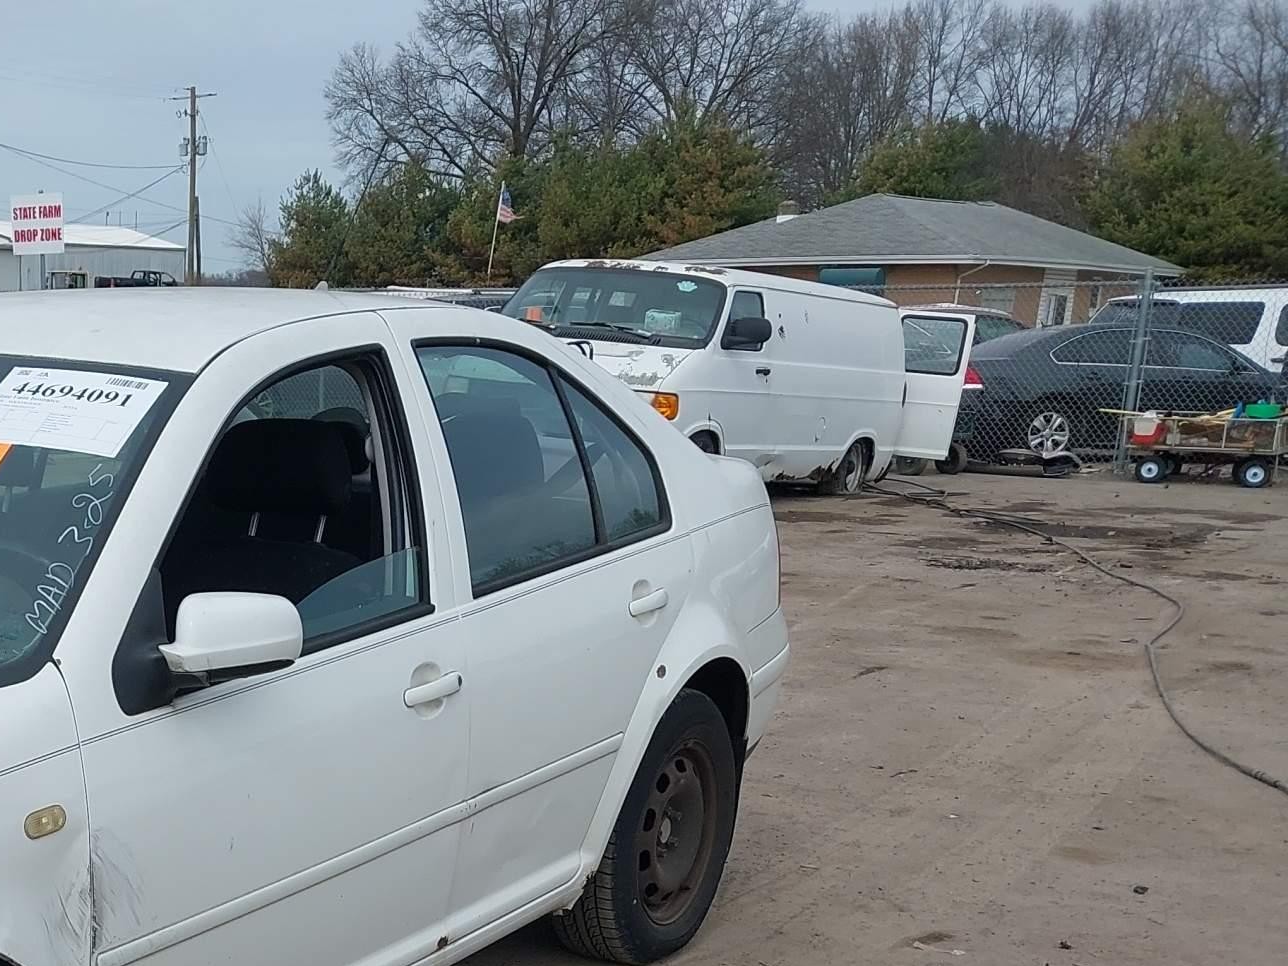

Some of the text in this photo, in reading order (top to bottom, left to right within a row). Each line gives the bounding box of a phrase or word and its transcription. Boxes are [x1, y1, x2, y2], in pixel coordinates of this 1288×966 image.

[12, 204, 61, 220] STATE FARM
[14, 227, 62, 243] DROP ZONE
[12, 381, 132, 408] 44694091
[25, 563, 74, 634] MAD
